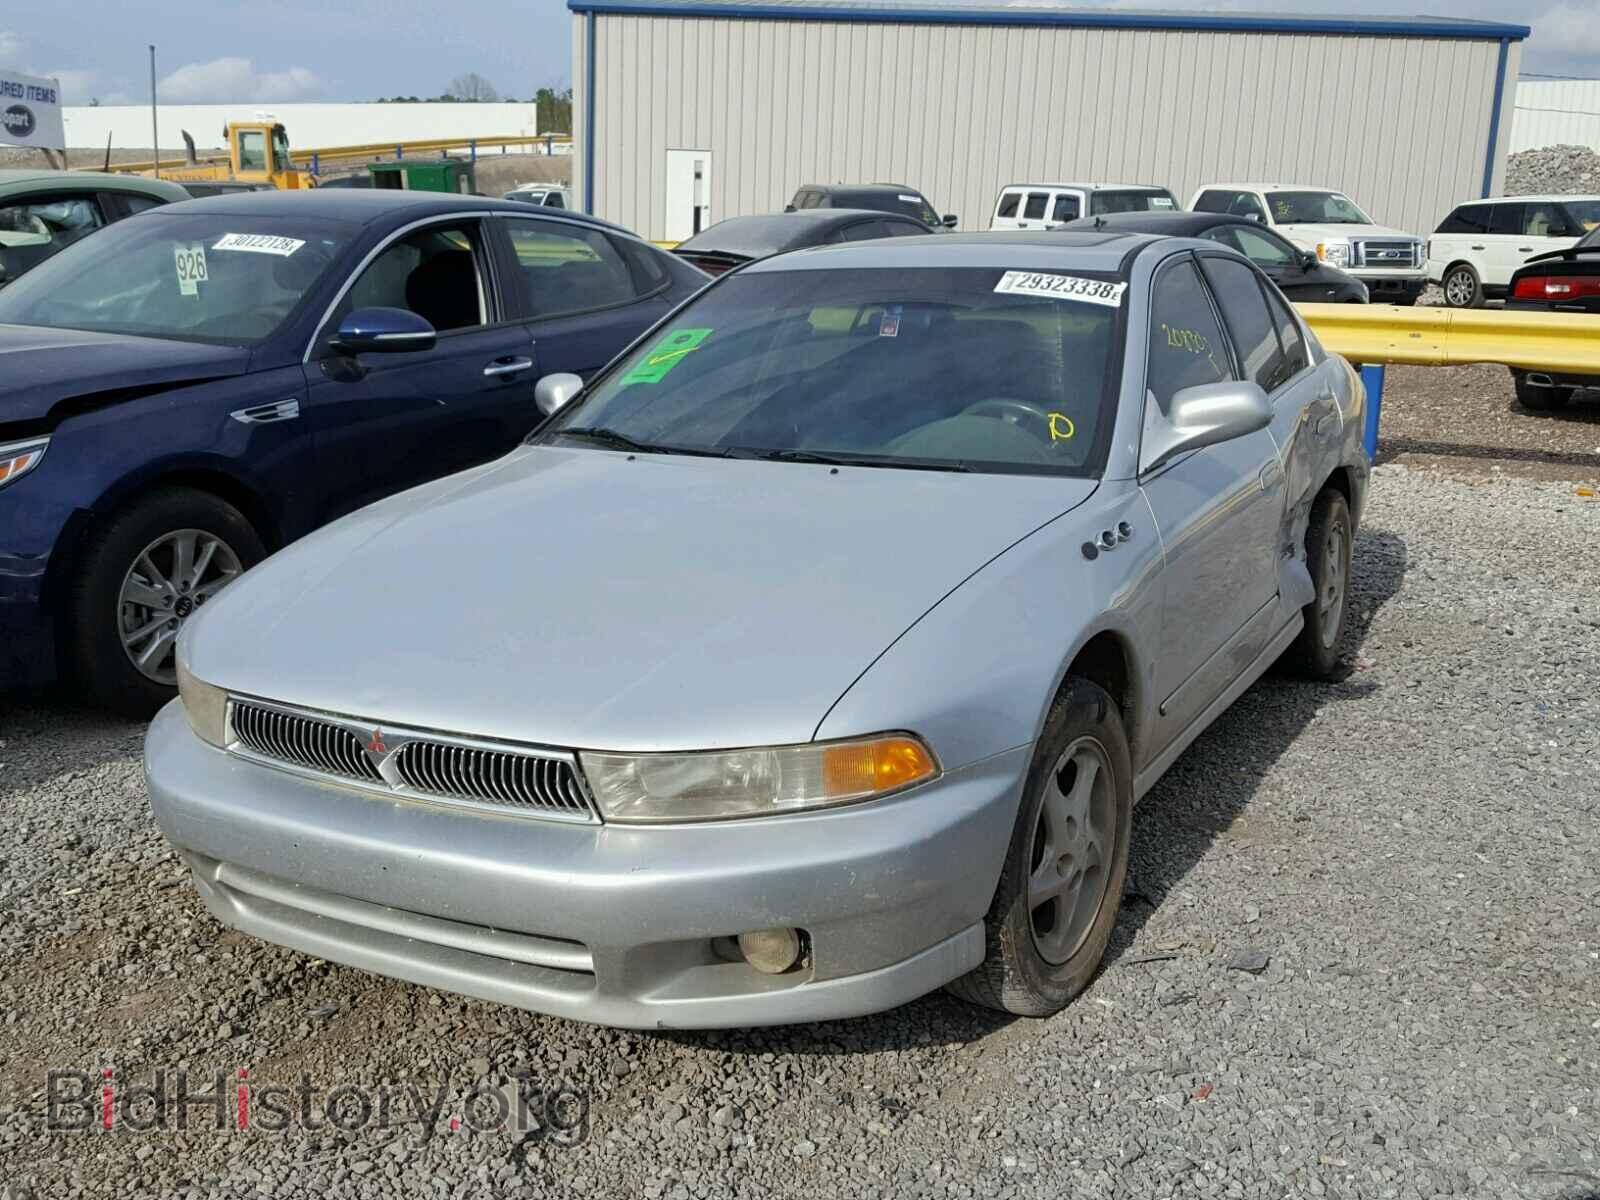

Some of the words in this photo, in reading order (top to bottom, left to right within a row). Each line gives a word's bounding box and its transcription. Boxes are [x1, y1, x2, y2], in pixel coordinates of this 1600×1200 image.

[27, 85, 57, 104] ITEMS
[177, 253, 206, 281] 926
[1016, 273, 1115, 299] 29323338
